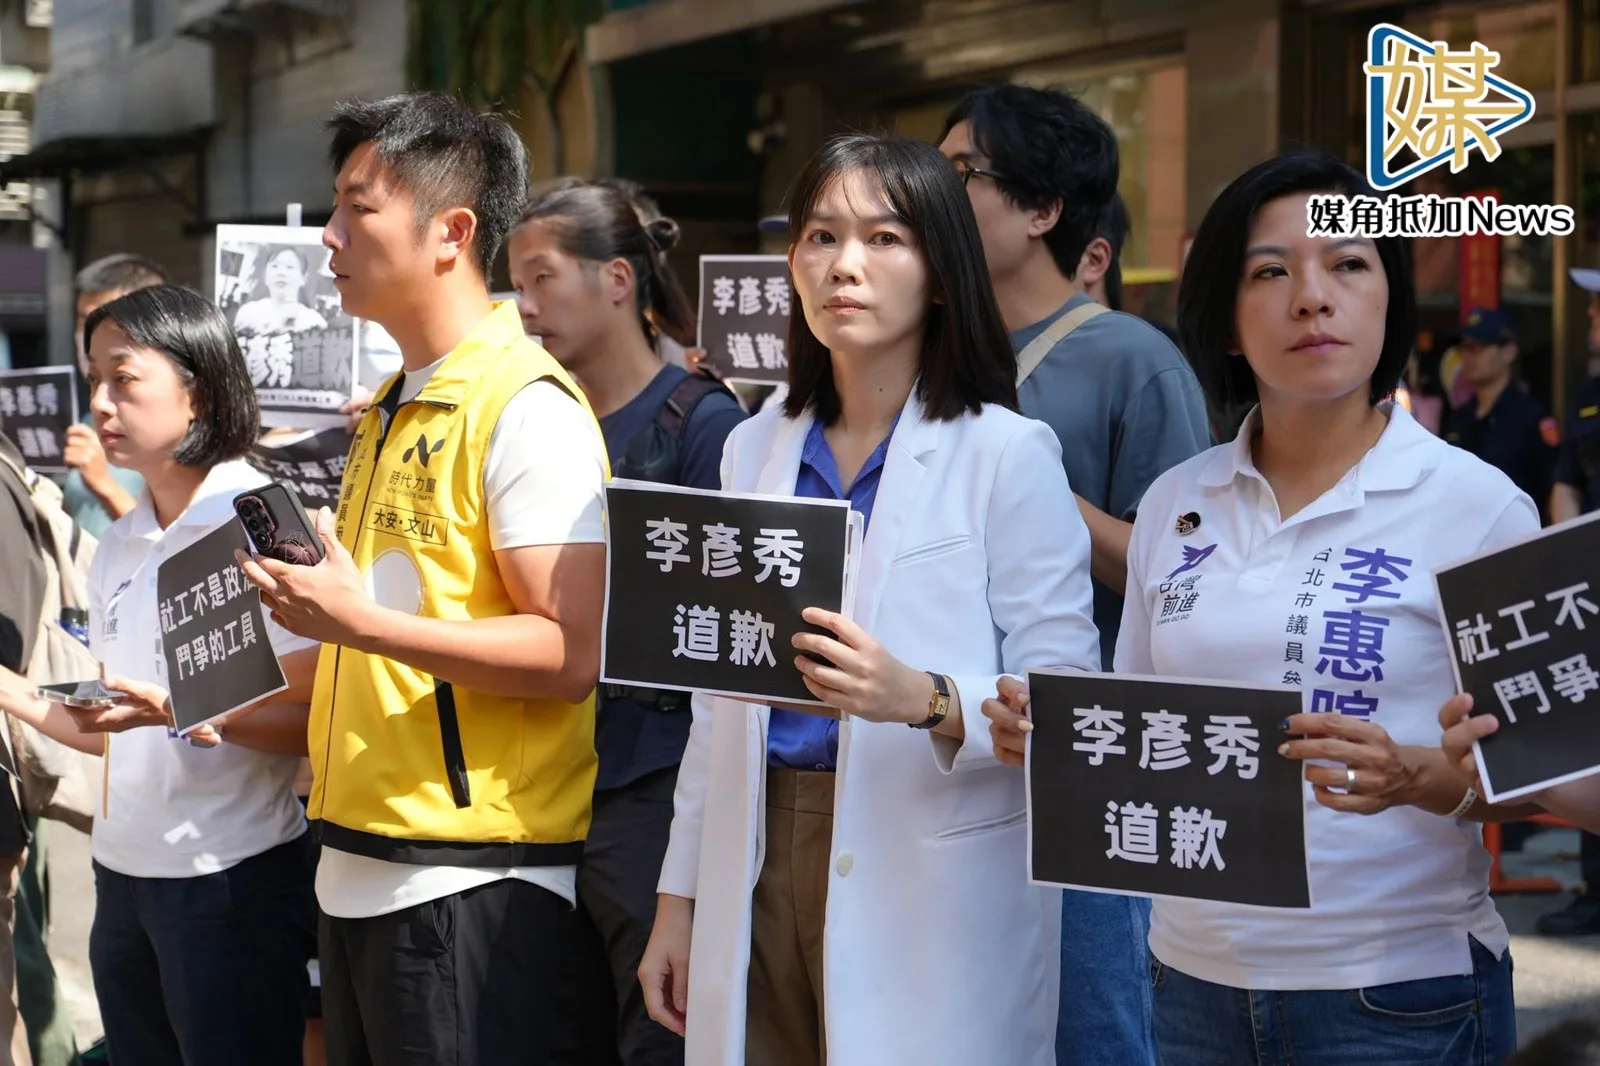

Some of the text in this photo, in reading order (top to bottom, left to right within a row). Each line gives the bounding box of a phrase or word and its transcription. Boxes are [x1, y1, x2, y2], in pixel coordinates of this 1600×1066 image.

[713, 276, 790, 316] 李彥秀
[727, 332, 789, 369] 道歉
[388, 470, 437, 494] 時代力量
[645, 517, 804, 587] 李彥秀
[672, 603, 777, 667] 道歉
[1160, 592, 1200, 618] 前進
[1456, 582, 1600, 665] 社工不
[175, 611, 257, 681] 鬥爭的工具
[1493, 653, 1600, 724] 鬥爭
[1072, 705, 1260, 779] 李彥秀
[1104, 800, 1227, 871] 道歉
